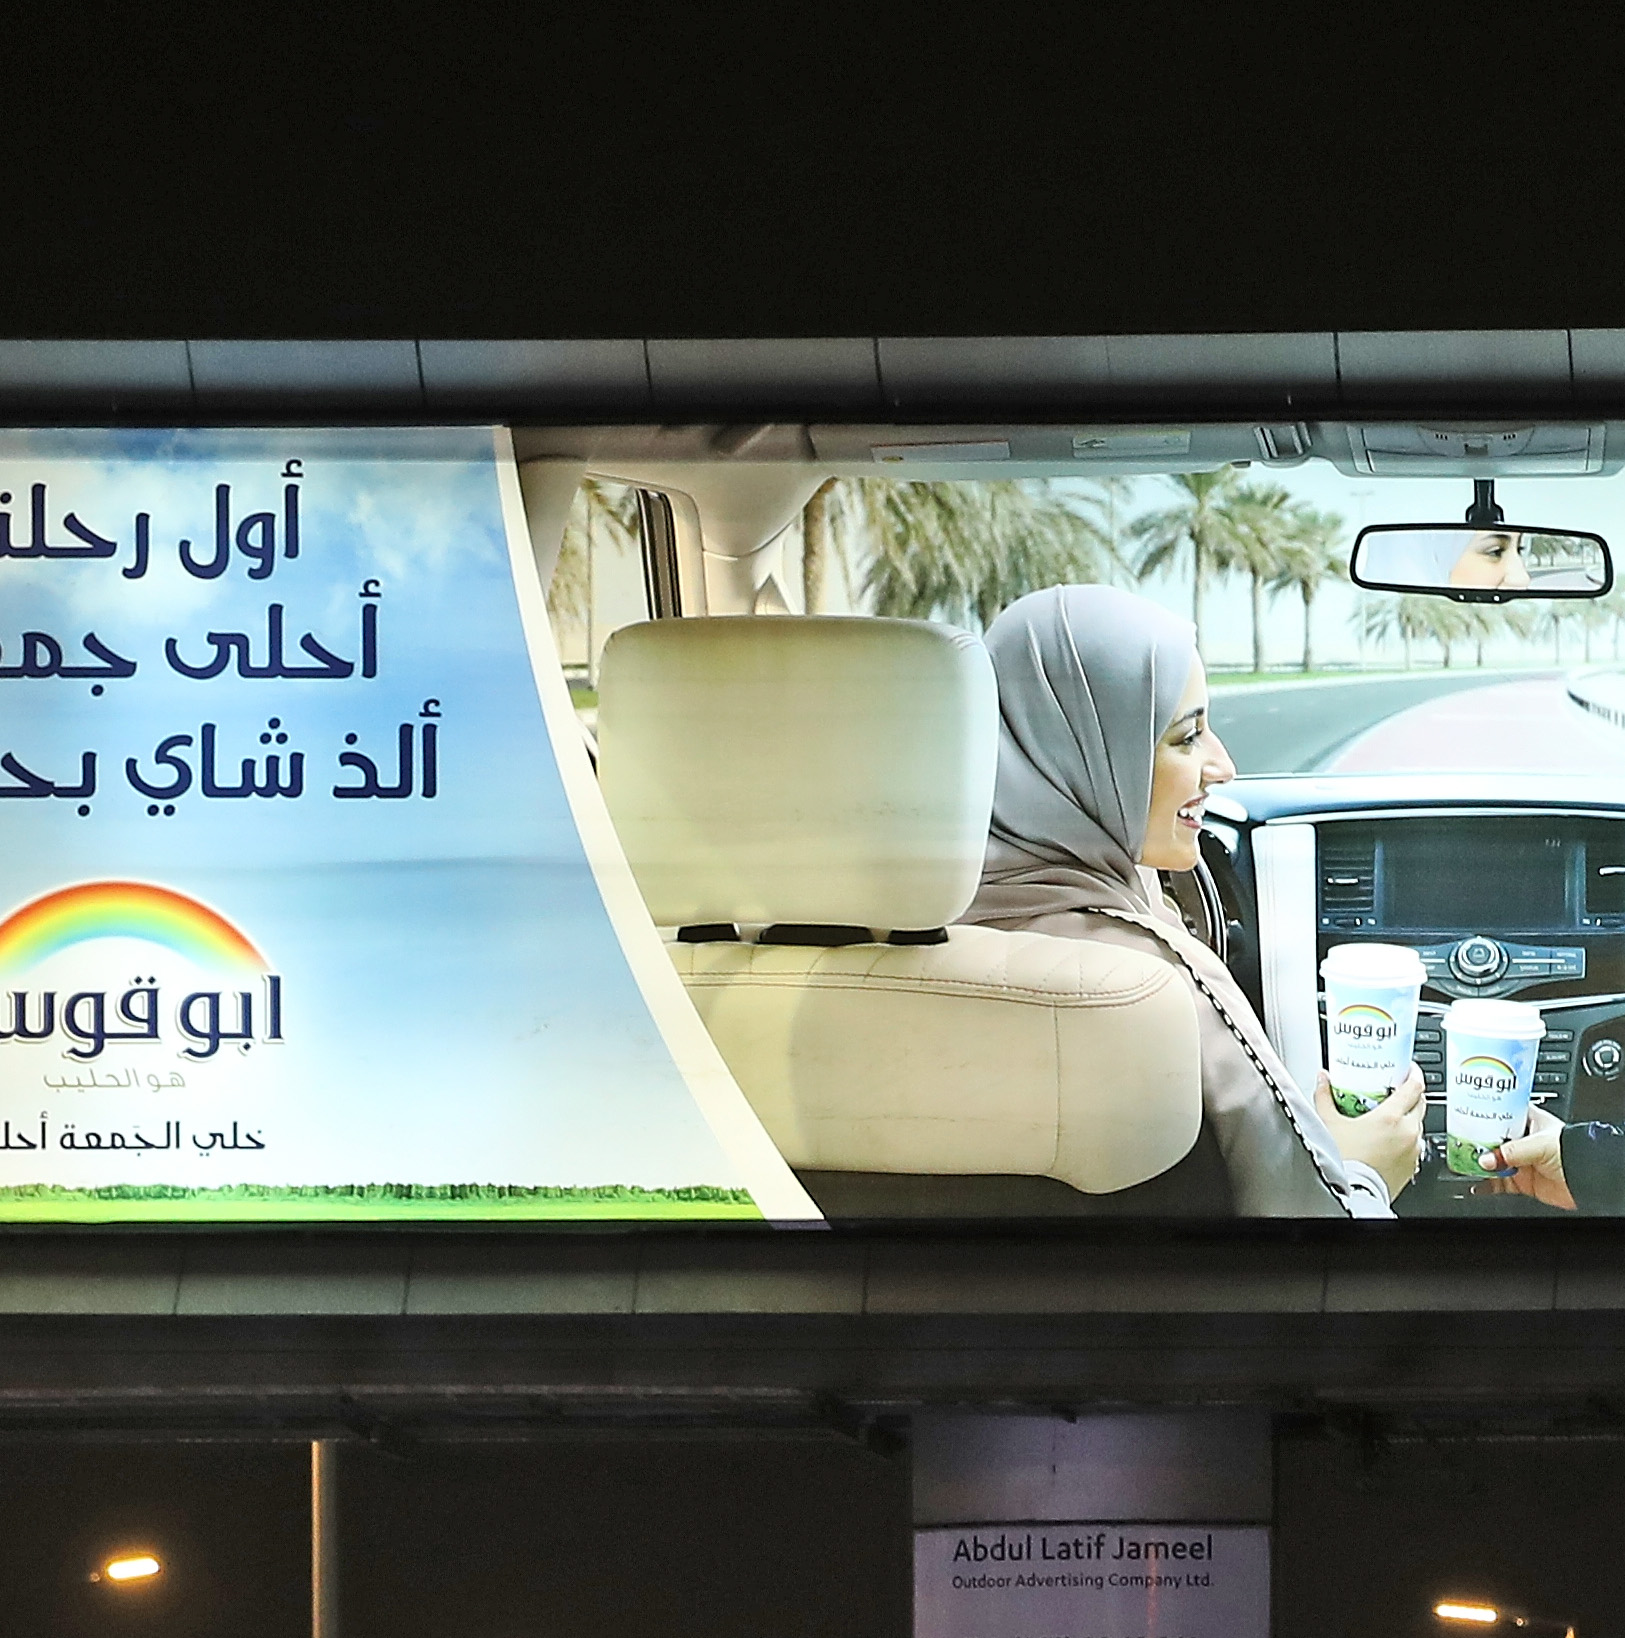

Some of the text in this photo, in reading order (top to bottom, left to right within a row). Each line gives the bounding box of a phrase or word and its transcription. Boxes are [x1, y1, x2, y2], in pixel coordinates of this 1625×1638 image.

[178, 458, 304, 581] أول
[165, 578, 383, 681] أحلى
[125, 717, 306, 817] شاي
[332, 698, 442, 800] ألذ
[177, 975, 284, 1062] ابو
[43, 1068, 186, 1093] هو الحليب
[193, 1120, 266, 1157] خلي
[952, 1572, 1215, 1590] Outdoor Advertising Company Ltd.
[953, 1534, 1213, 1562] Abdul Latif Jameel
